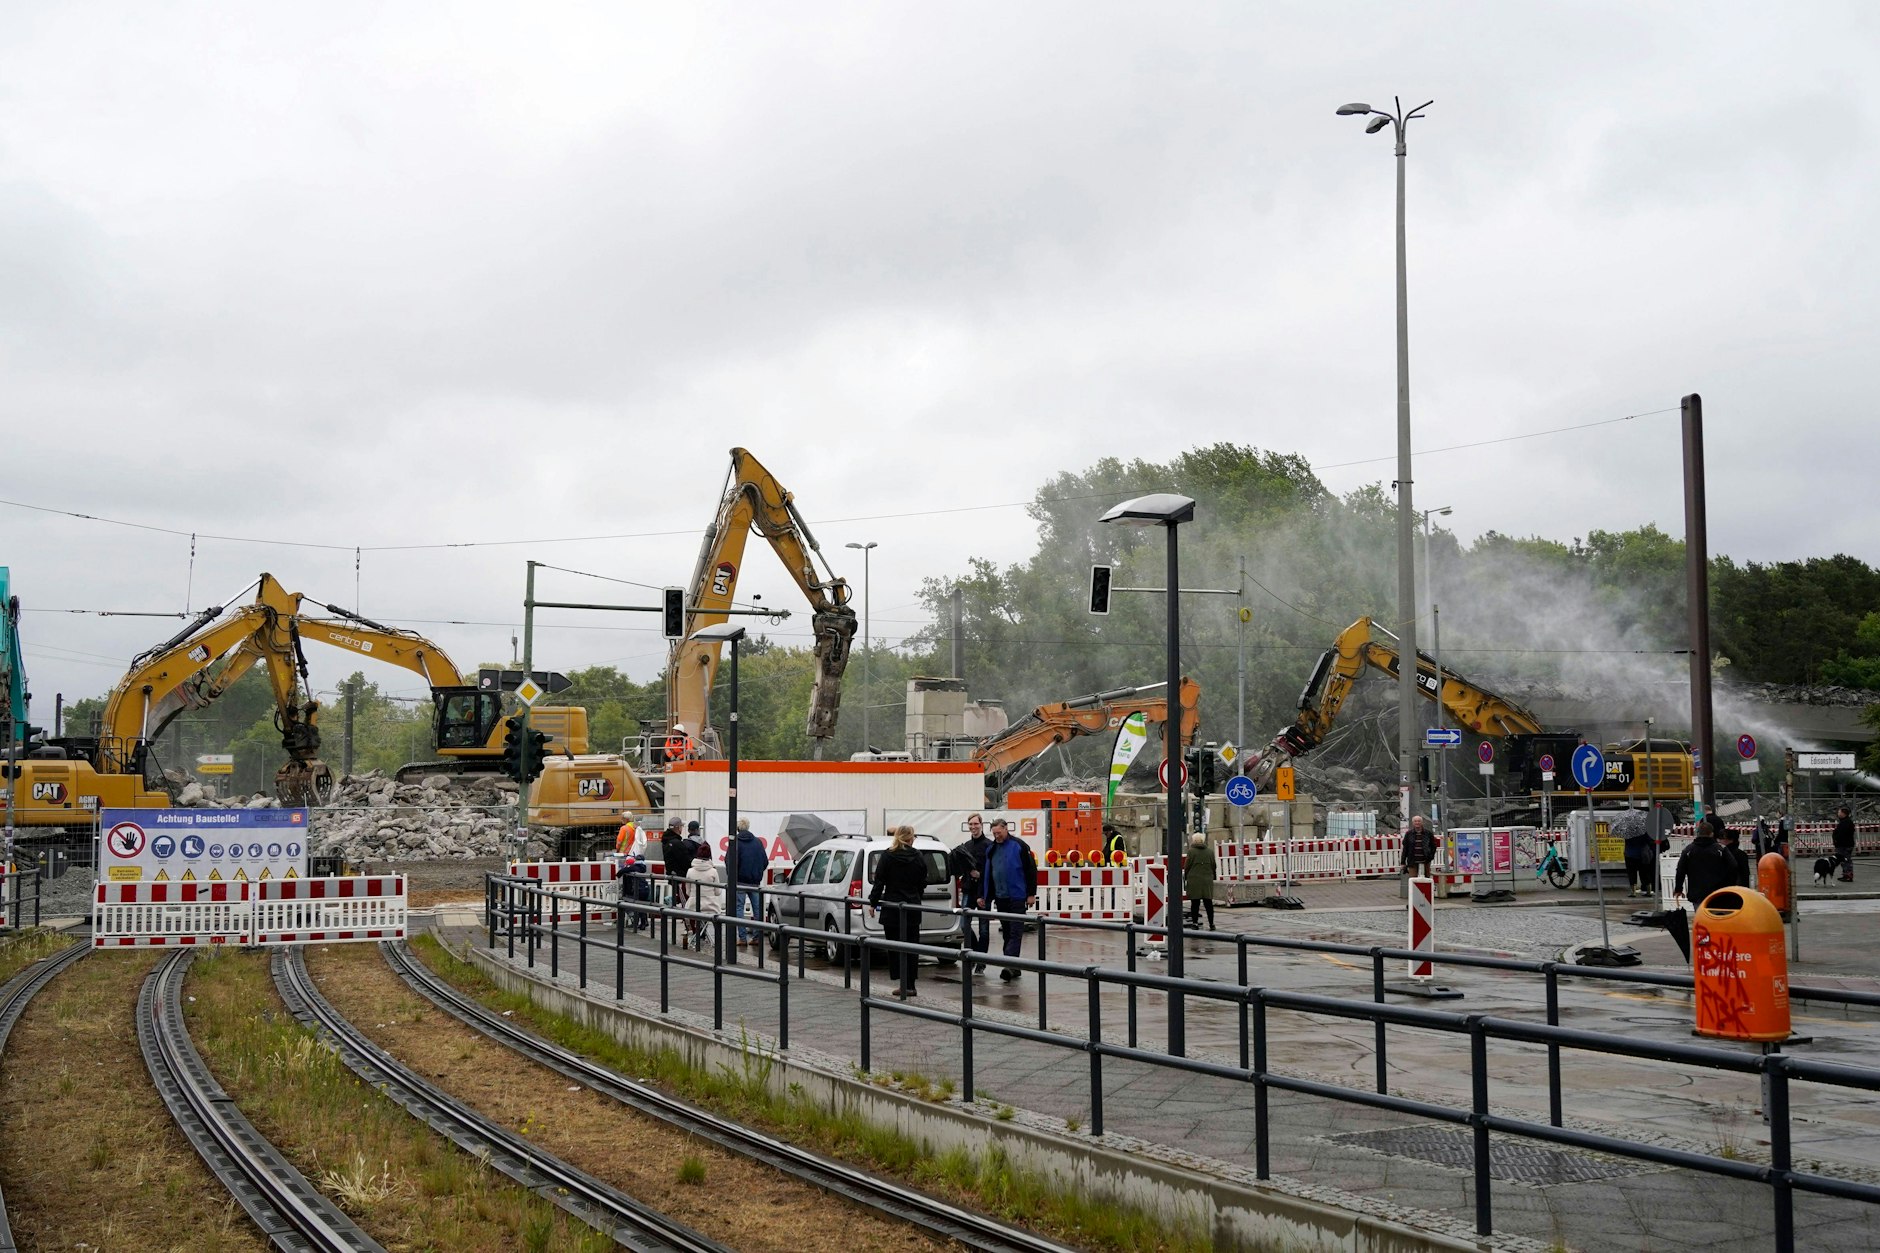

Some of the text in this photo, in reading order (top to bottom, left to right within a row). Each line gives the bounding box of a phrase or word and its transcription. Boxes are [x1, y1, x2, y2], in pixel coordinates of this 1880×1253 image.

[712, 567, 732, 596] CAT
[328, 632, 361, 647] centro
[1810, 756, 1842, 765] Edisonstraße
[1605, 761, 1624, 774] CAT
[1282, 770, 1289, 778] U
[1618, 773, 1630, 783] 01
[33, 783, 60, 800] CAT
[578, 779, 606, 796] CAT
[78, 795, 99, 804] AGMT
[156, 813, 240, 824] Achtung Baustelle!
[254, 813, 289, 823] centro
